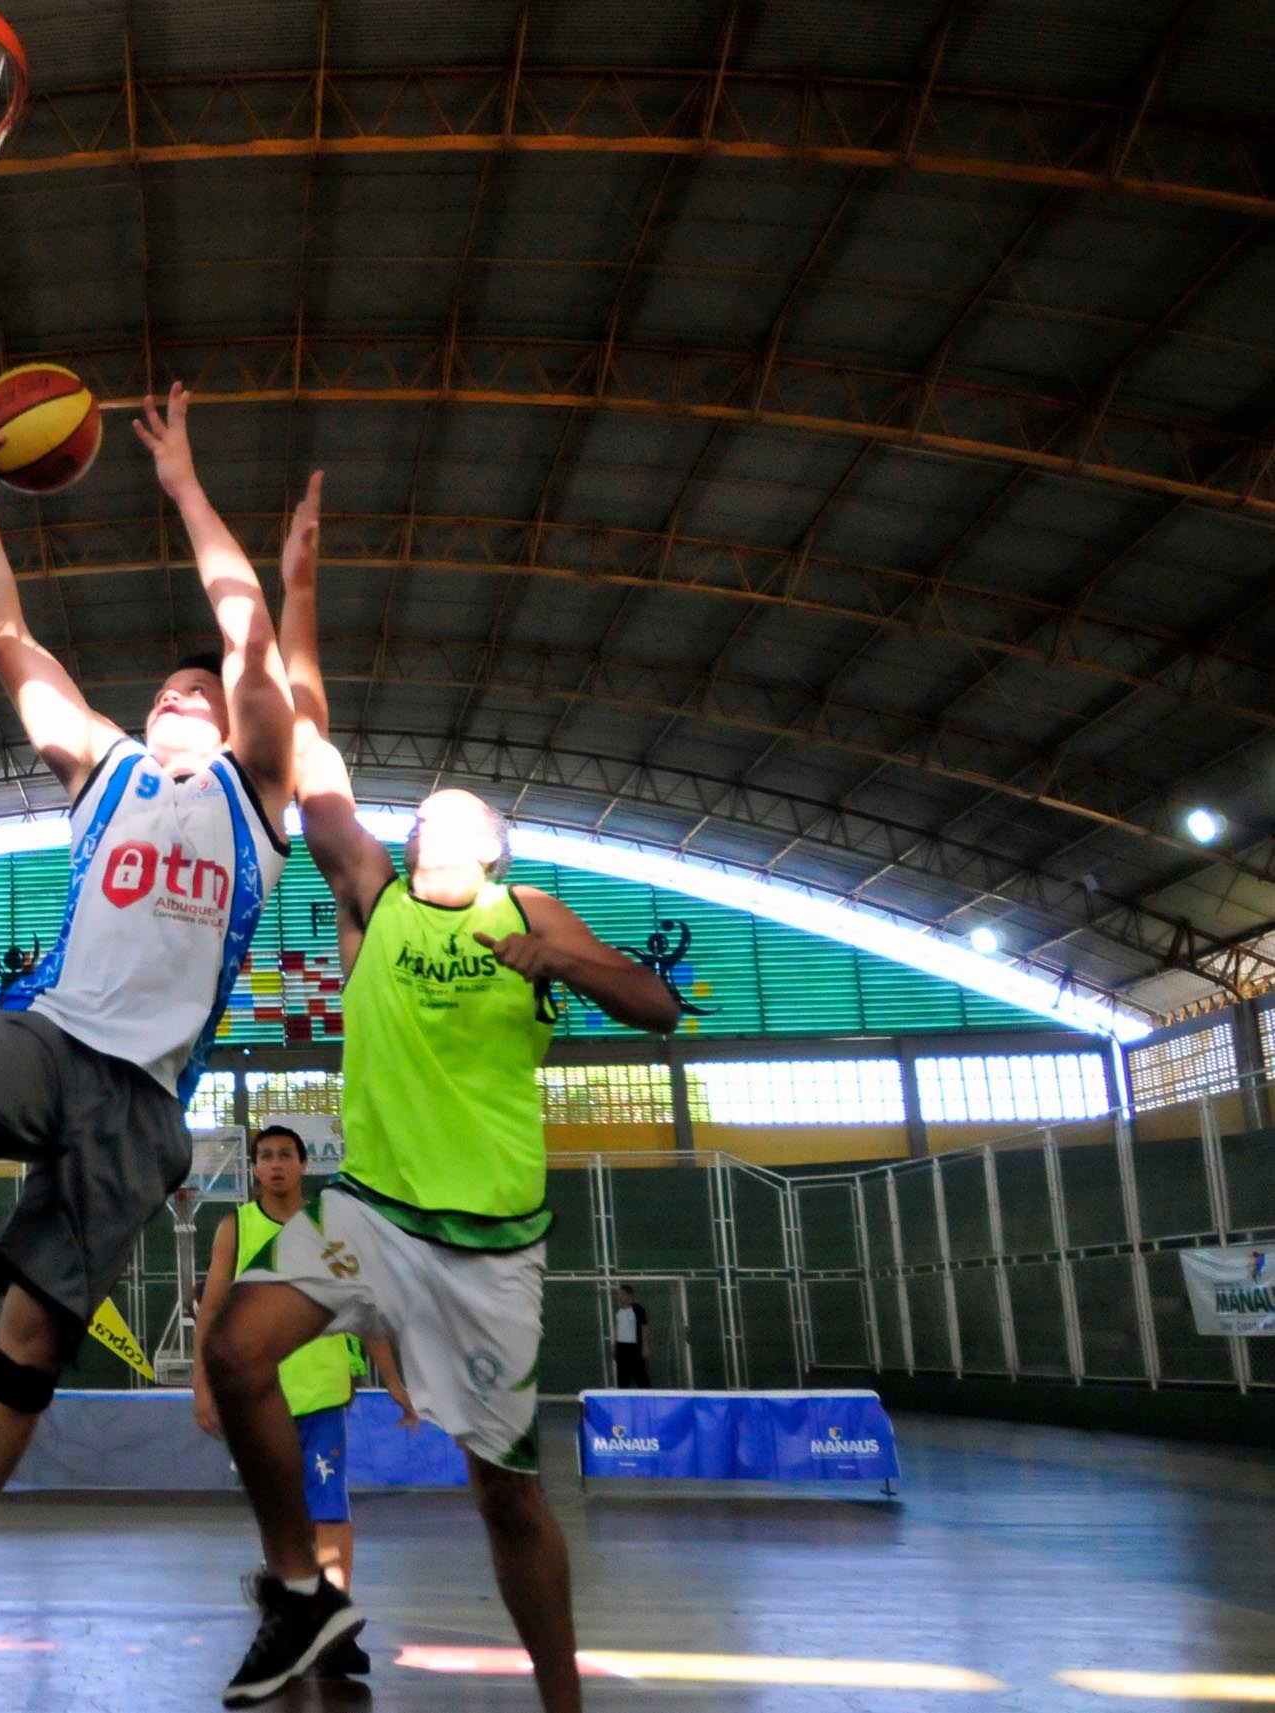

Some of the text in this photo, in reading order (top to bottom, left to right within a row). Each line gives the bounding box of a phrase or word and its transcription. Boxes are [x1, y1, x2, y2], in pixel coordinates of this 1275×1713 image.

[135, 772, 161, 800] 9
[396, 946, 497, 983] MANAUS
[593, 1438, 660, 1451] MANAUS
[811, 1440, 879, 1453] MANAUS
